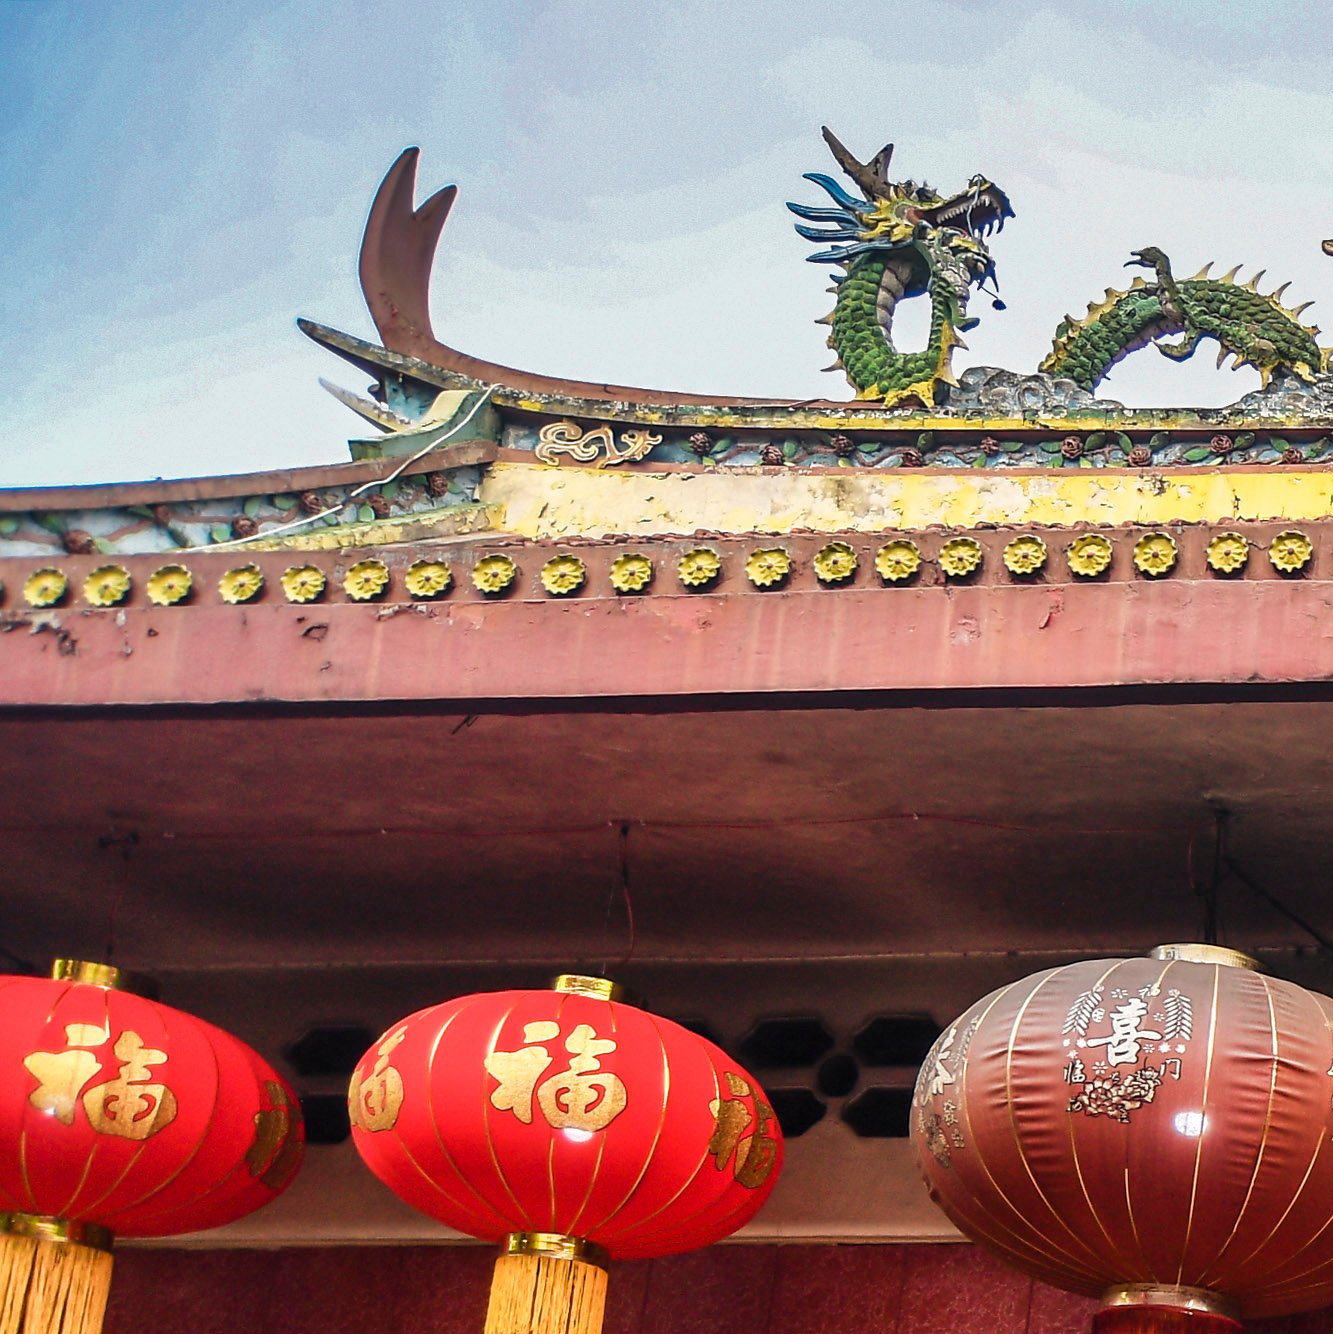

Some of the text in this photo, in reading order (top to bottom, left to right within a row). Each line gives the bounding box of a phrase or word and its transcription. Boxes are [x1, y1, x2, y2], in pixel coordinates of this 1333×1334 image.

[23, 1022, 179, 1141] 福
[484, 1020, 628, 1132] 福
[1086, 997, 1163, 1068] 喜
